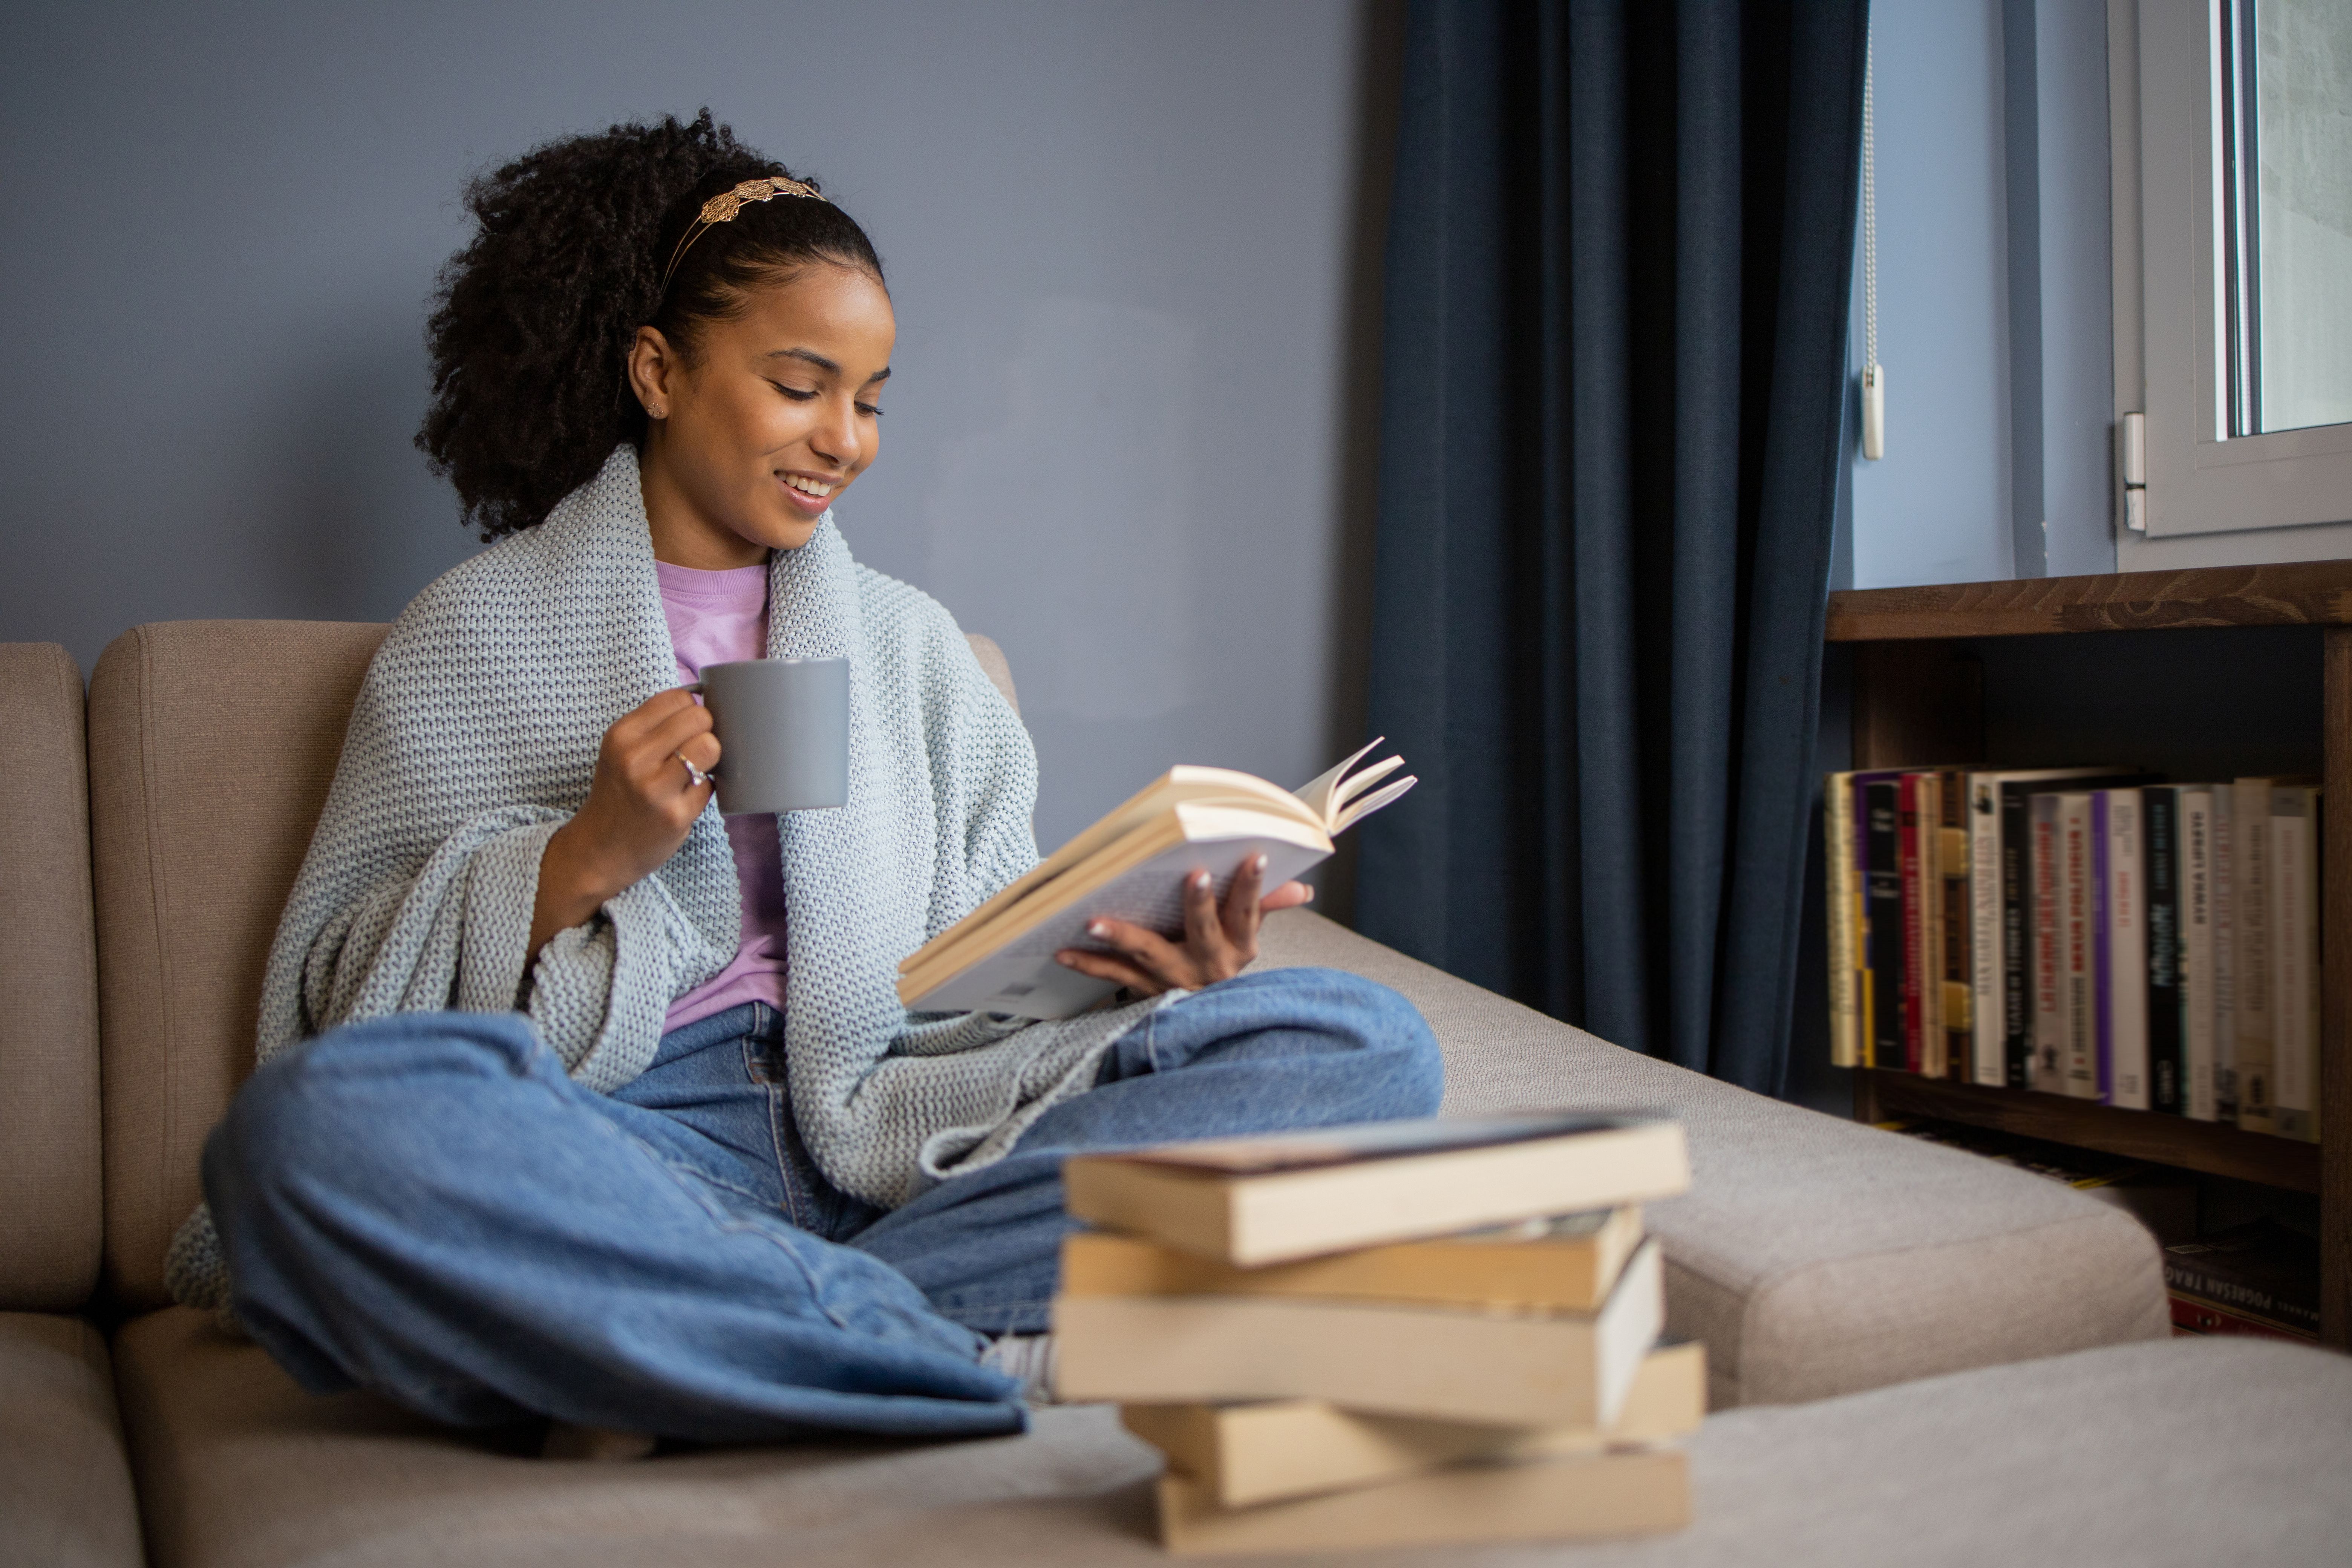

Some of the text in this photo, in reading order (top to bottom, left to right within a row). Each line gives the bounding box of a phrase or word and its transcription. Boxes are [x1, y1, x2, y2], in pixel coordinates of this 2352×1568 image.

[2067, 830, 2083, 917] POLITICUS
[2165, 1265, 2203, 1291] TRAG
[2206, 1277, 2272, 1310] POGREŠAN
